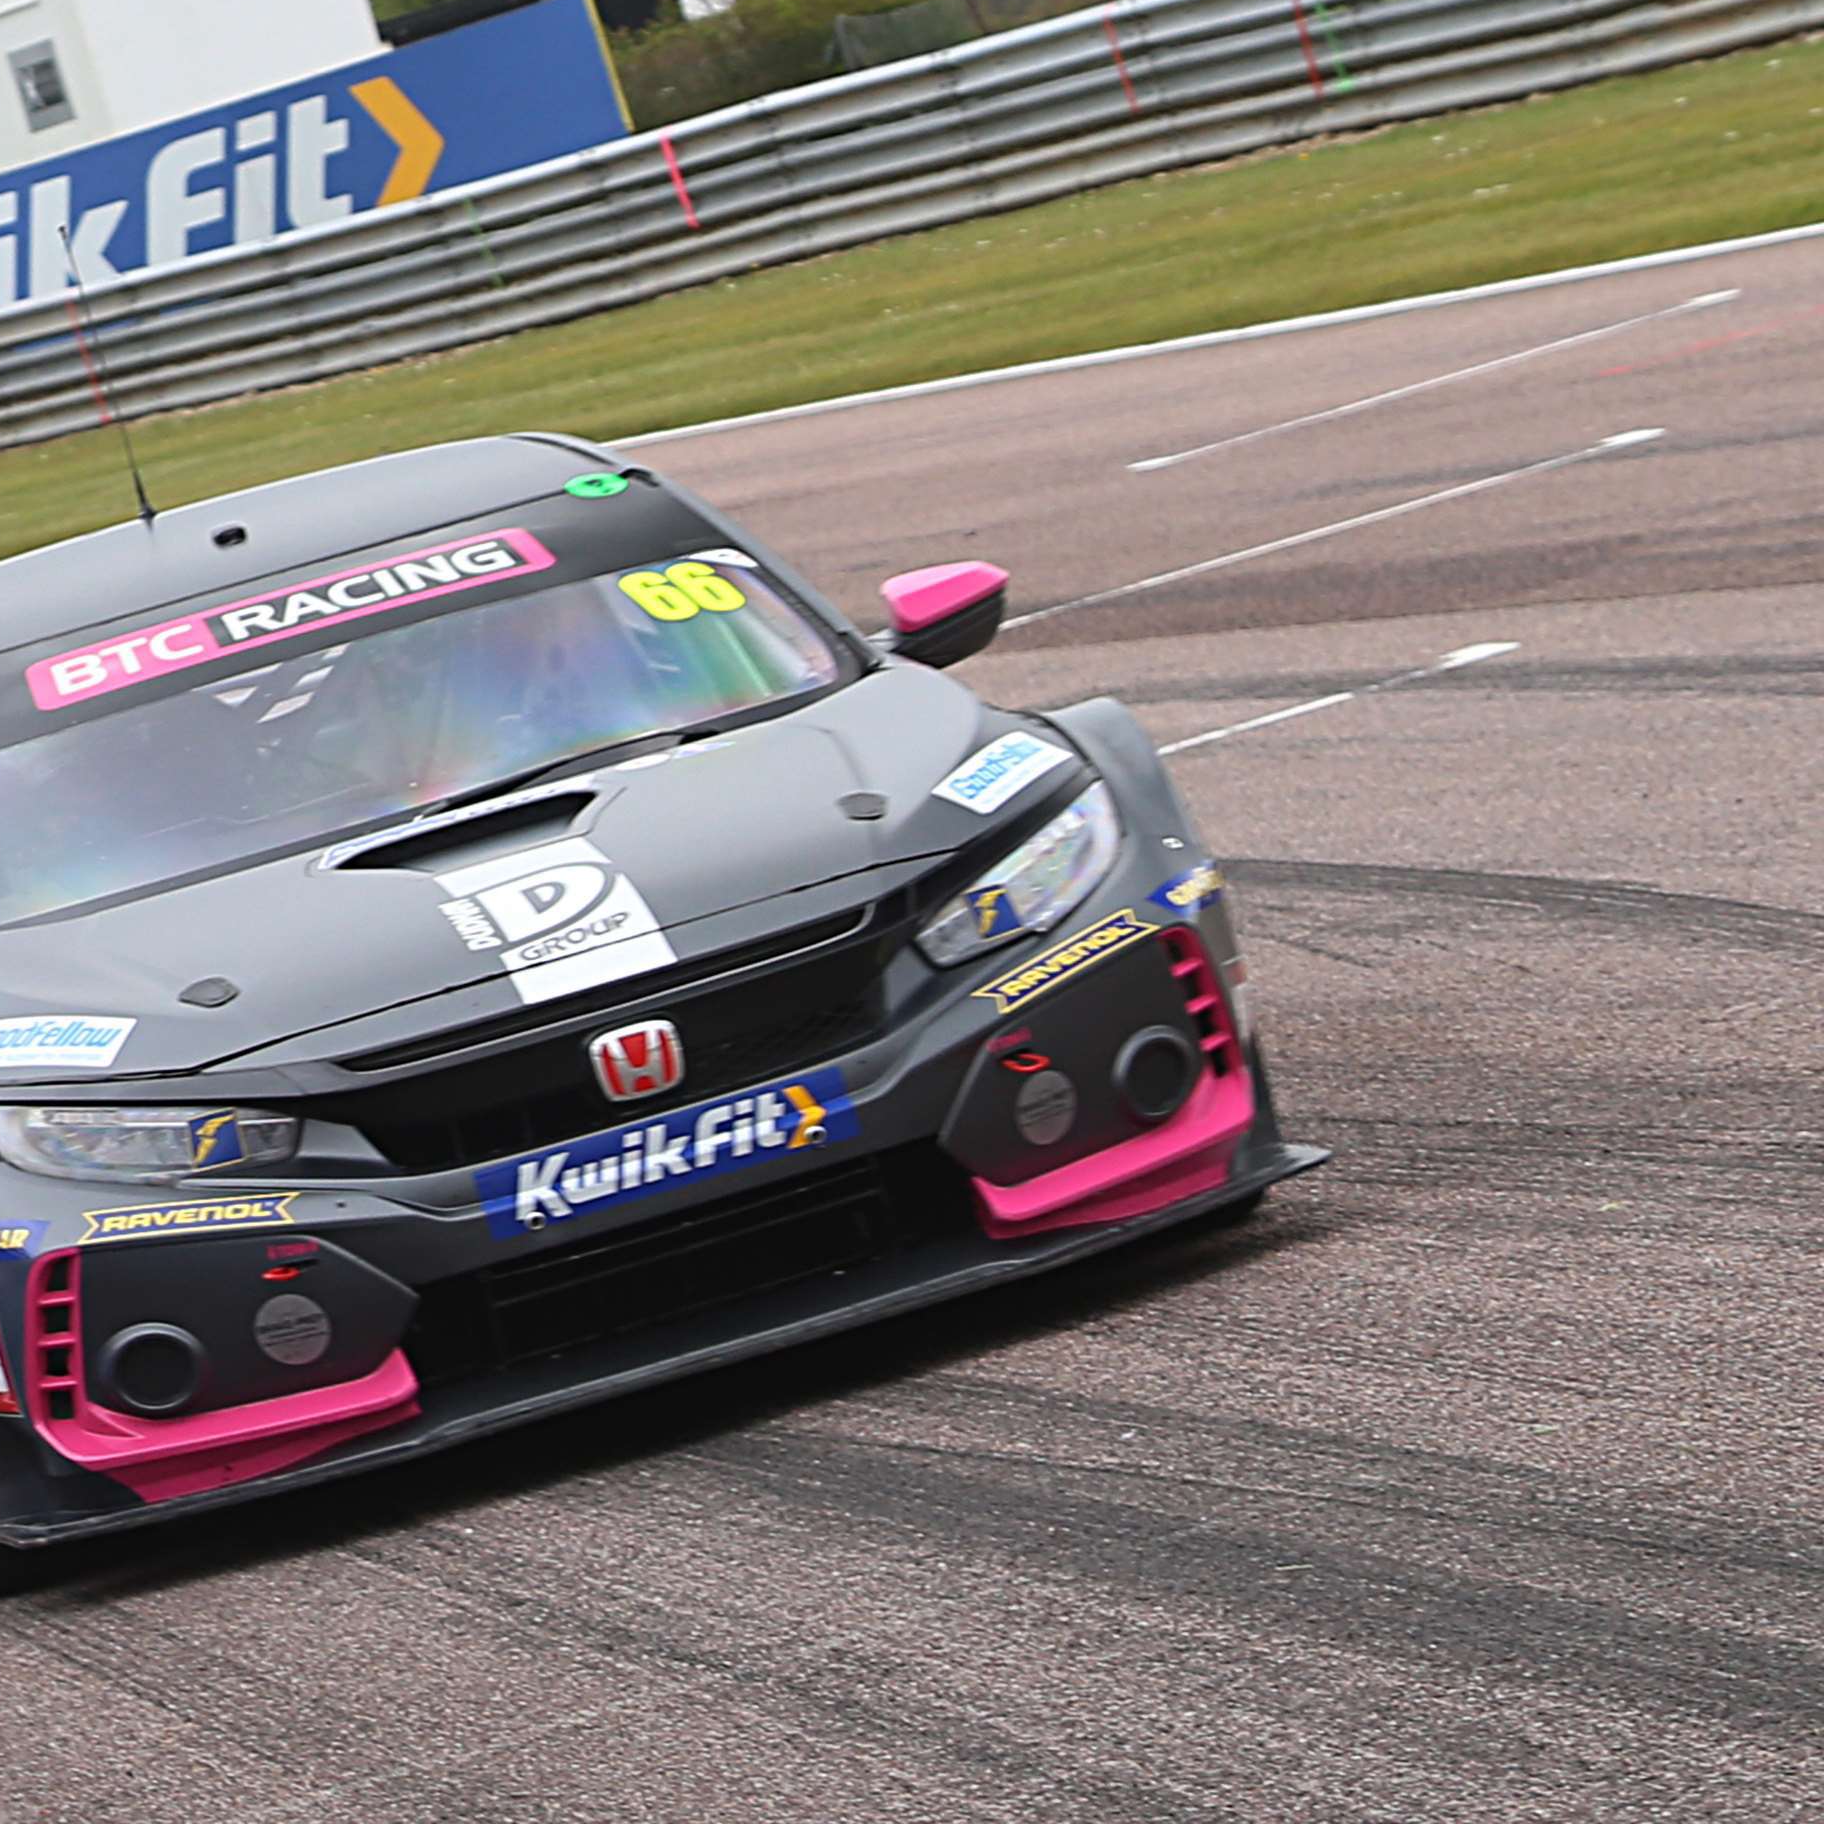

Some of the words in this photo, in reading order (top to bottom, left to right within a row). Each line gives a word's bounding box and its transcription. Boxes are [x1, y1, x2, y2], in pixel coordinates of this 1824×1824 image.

[50, 623, 204, 696] BTC
[221, 542, 517, 642] RACING
[617, 562, 747, 621] 66
[519, 911, 630, 961] GROUP
[999, 926, 1136, 997] RAVENOL
[101, 1202, 270, 1232] RAVENOL
